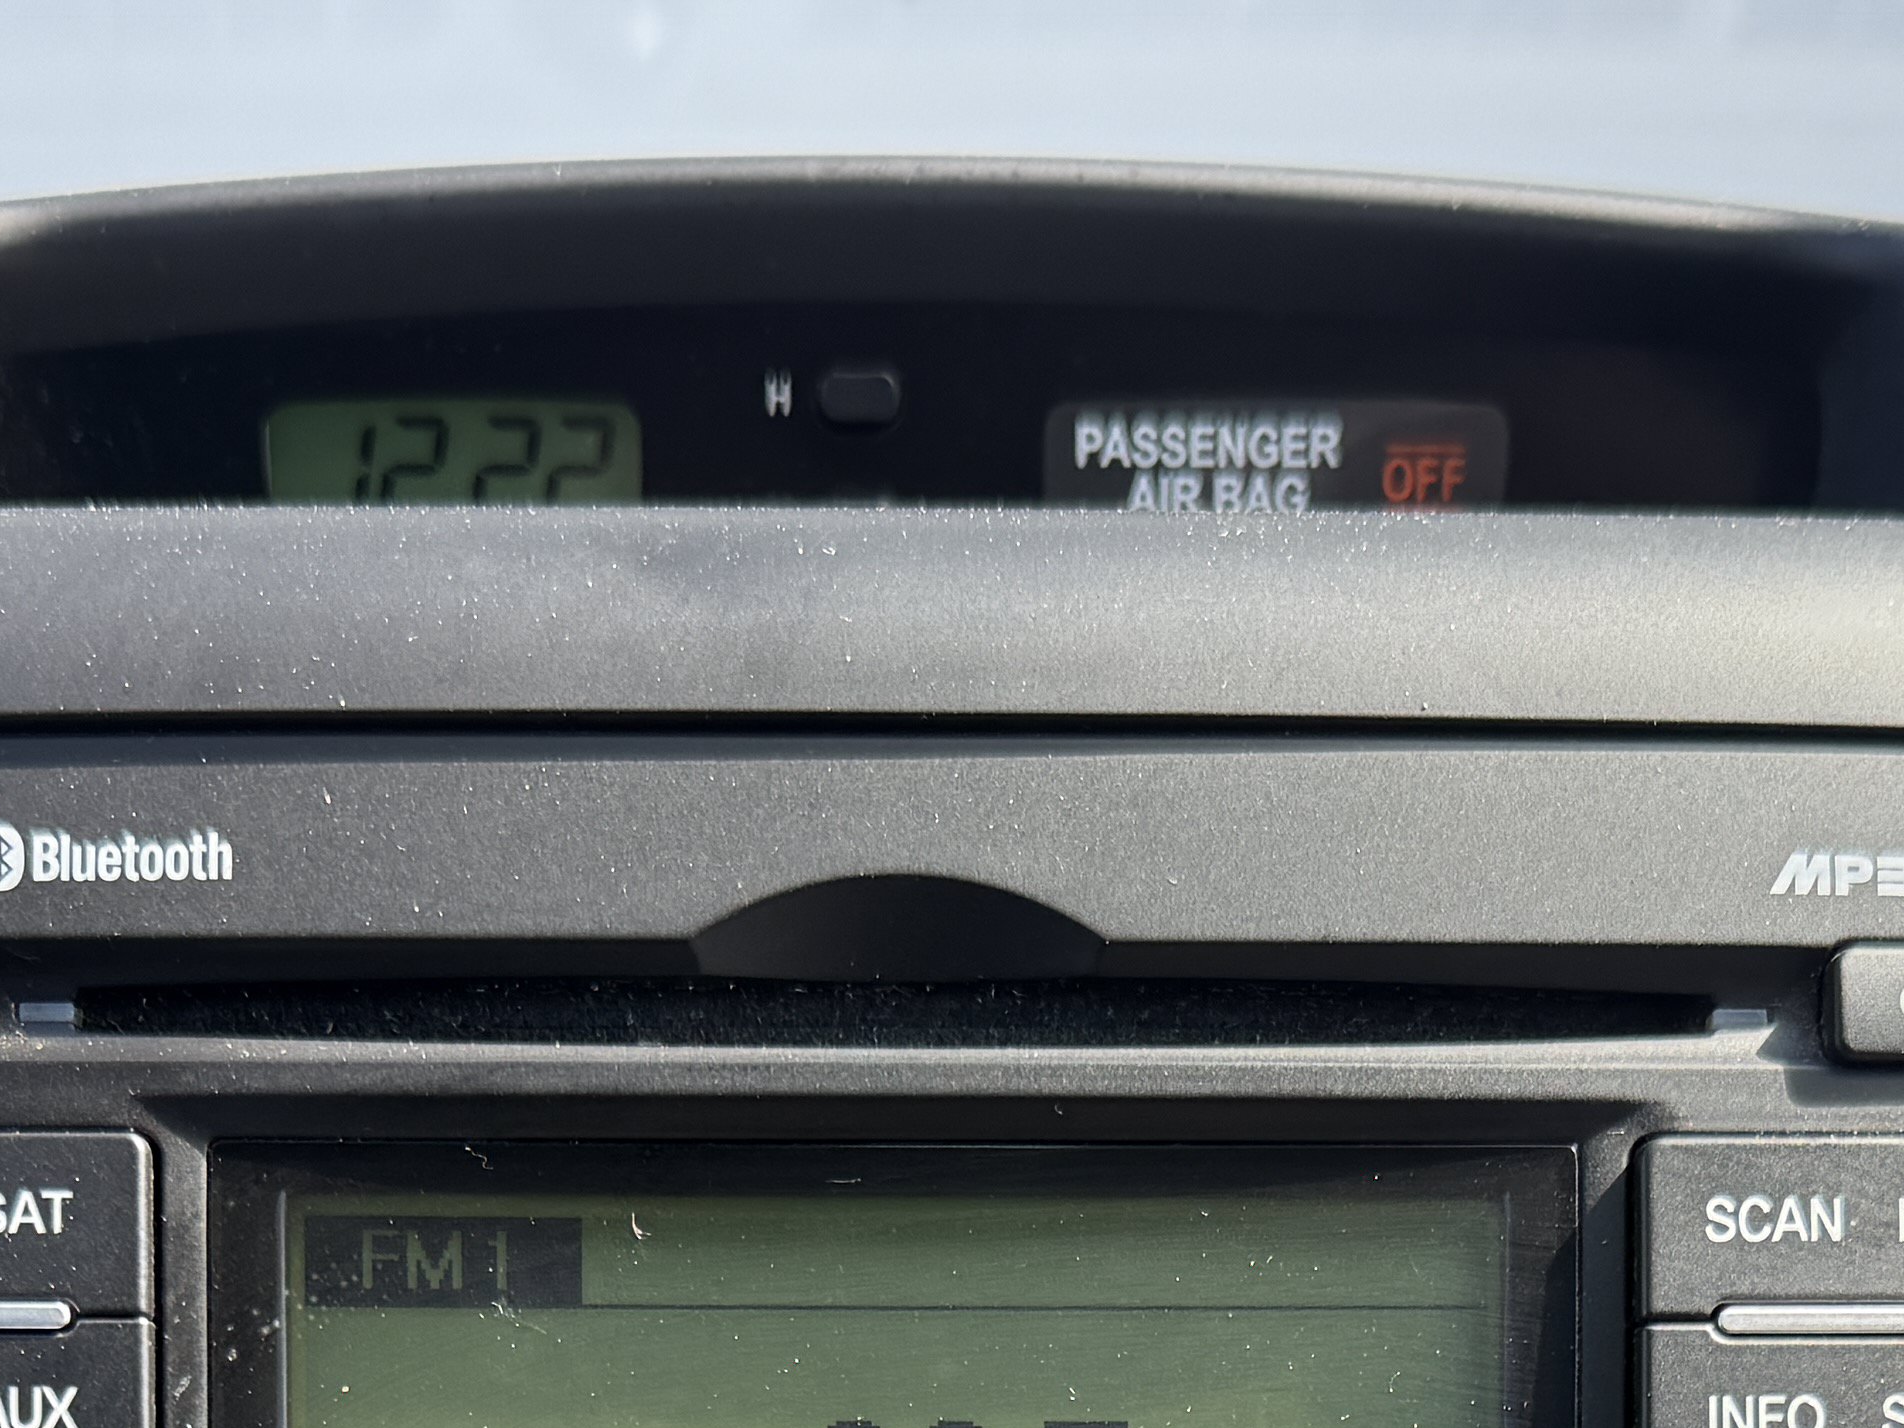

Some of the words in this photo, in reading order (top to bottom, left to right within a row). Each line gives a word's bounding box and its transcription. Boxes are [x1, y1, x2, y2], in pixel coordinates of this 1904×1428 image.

[1074, 411, 1343, 470] PASSENGER
[1127, 471, 1202, 513] AIR
[1213, 471, 1311, 513] BAG
[1381, 457, 1467, 503] OFF
[31, 830, 234, 883] Bluetooth
[1705, 1195, 1844, 1244] SCAN
[361, 1229, 508, 1290] FM1
